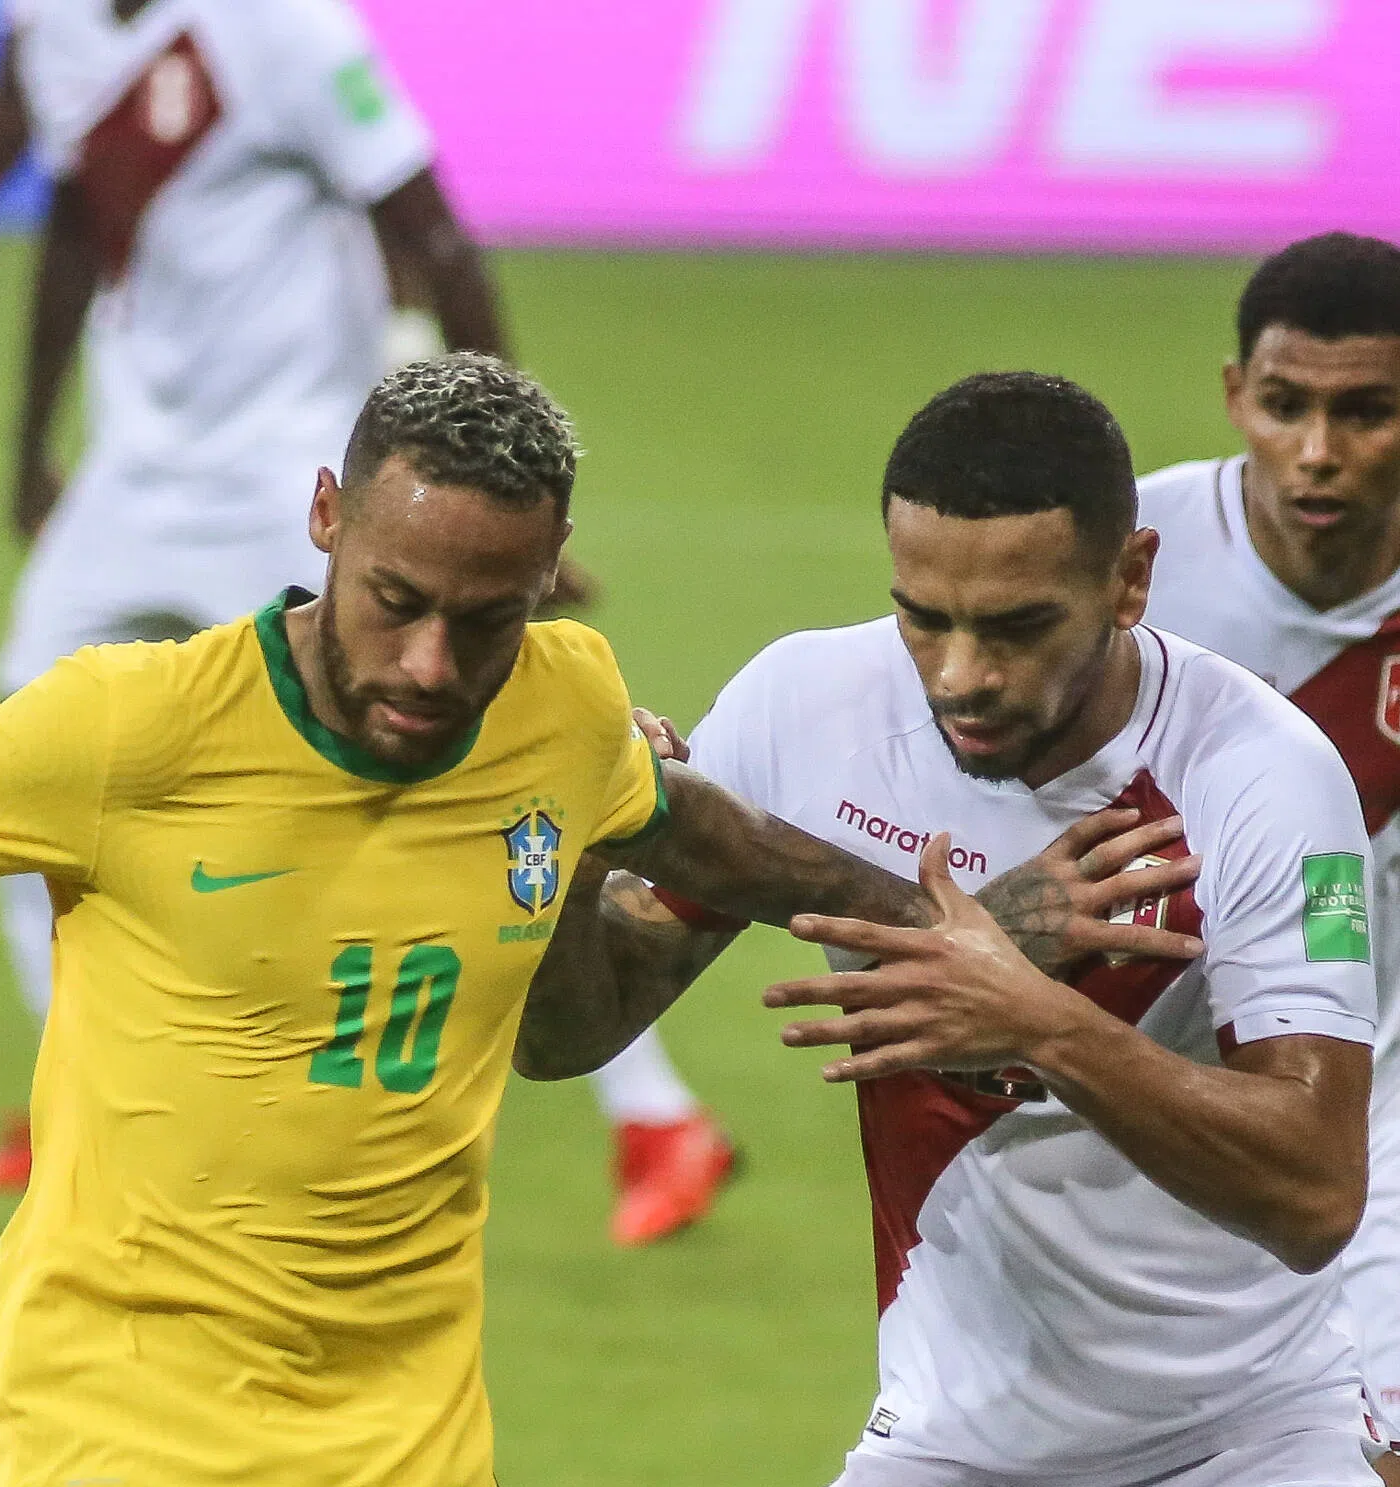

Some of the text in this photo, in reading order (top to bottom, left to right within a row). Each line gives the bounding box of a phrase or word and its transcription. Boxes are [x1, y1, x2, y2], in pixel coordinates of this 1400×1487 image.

[525, 853, 547, 866] CBF
[836, 799, 984, 875] maraton
[308, 944, 463, 1094] 10
